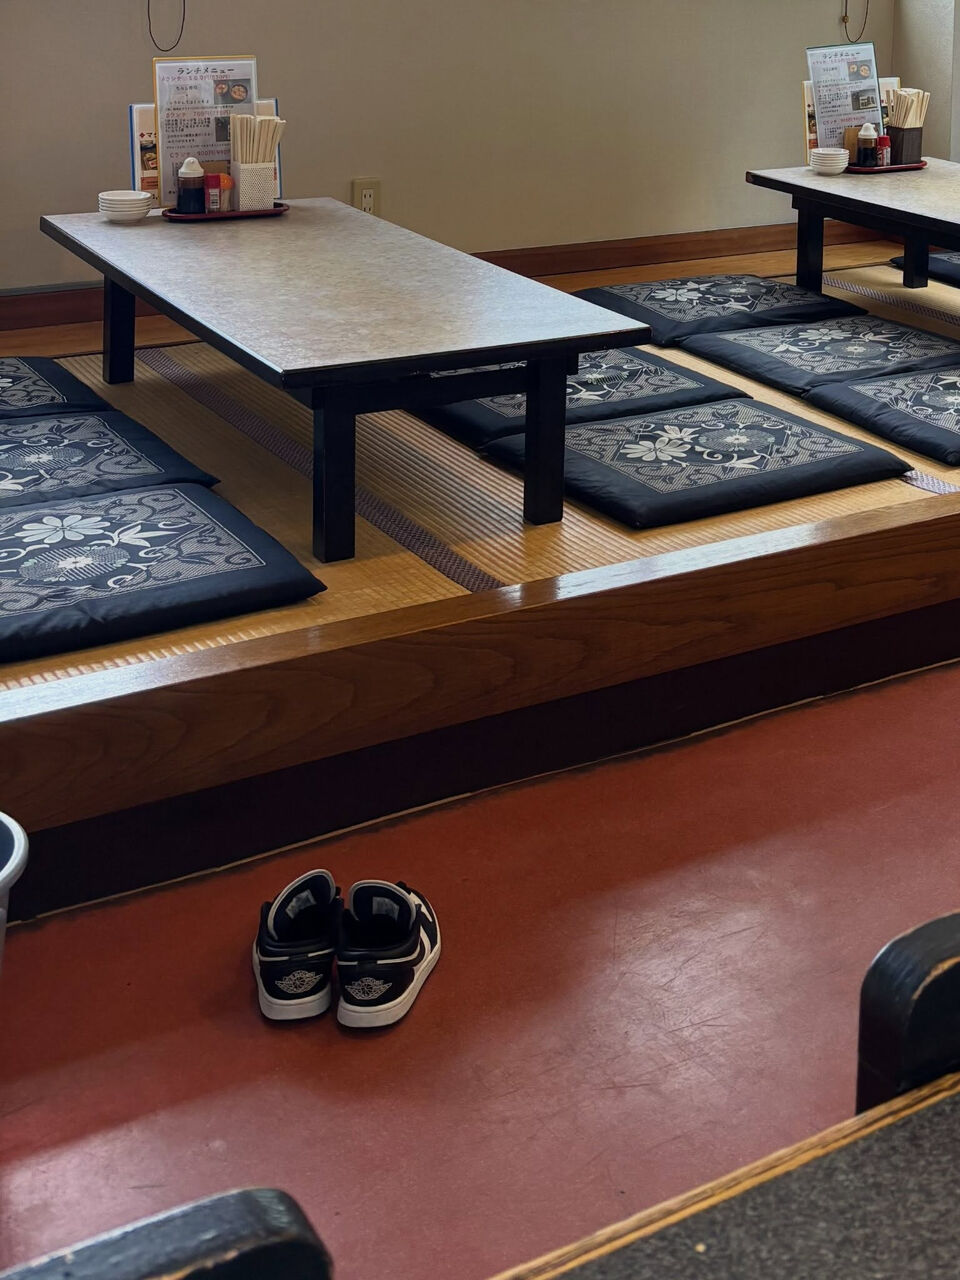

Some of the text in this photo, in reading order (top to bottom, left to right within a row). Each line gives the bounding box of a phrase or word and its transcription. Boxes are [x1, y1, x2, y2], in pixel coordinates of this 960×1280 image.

[177, 67, 235, 75] ランチメニュー
